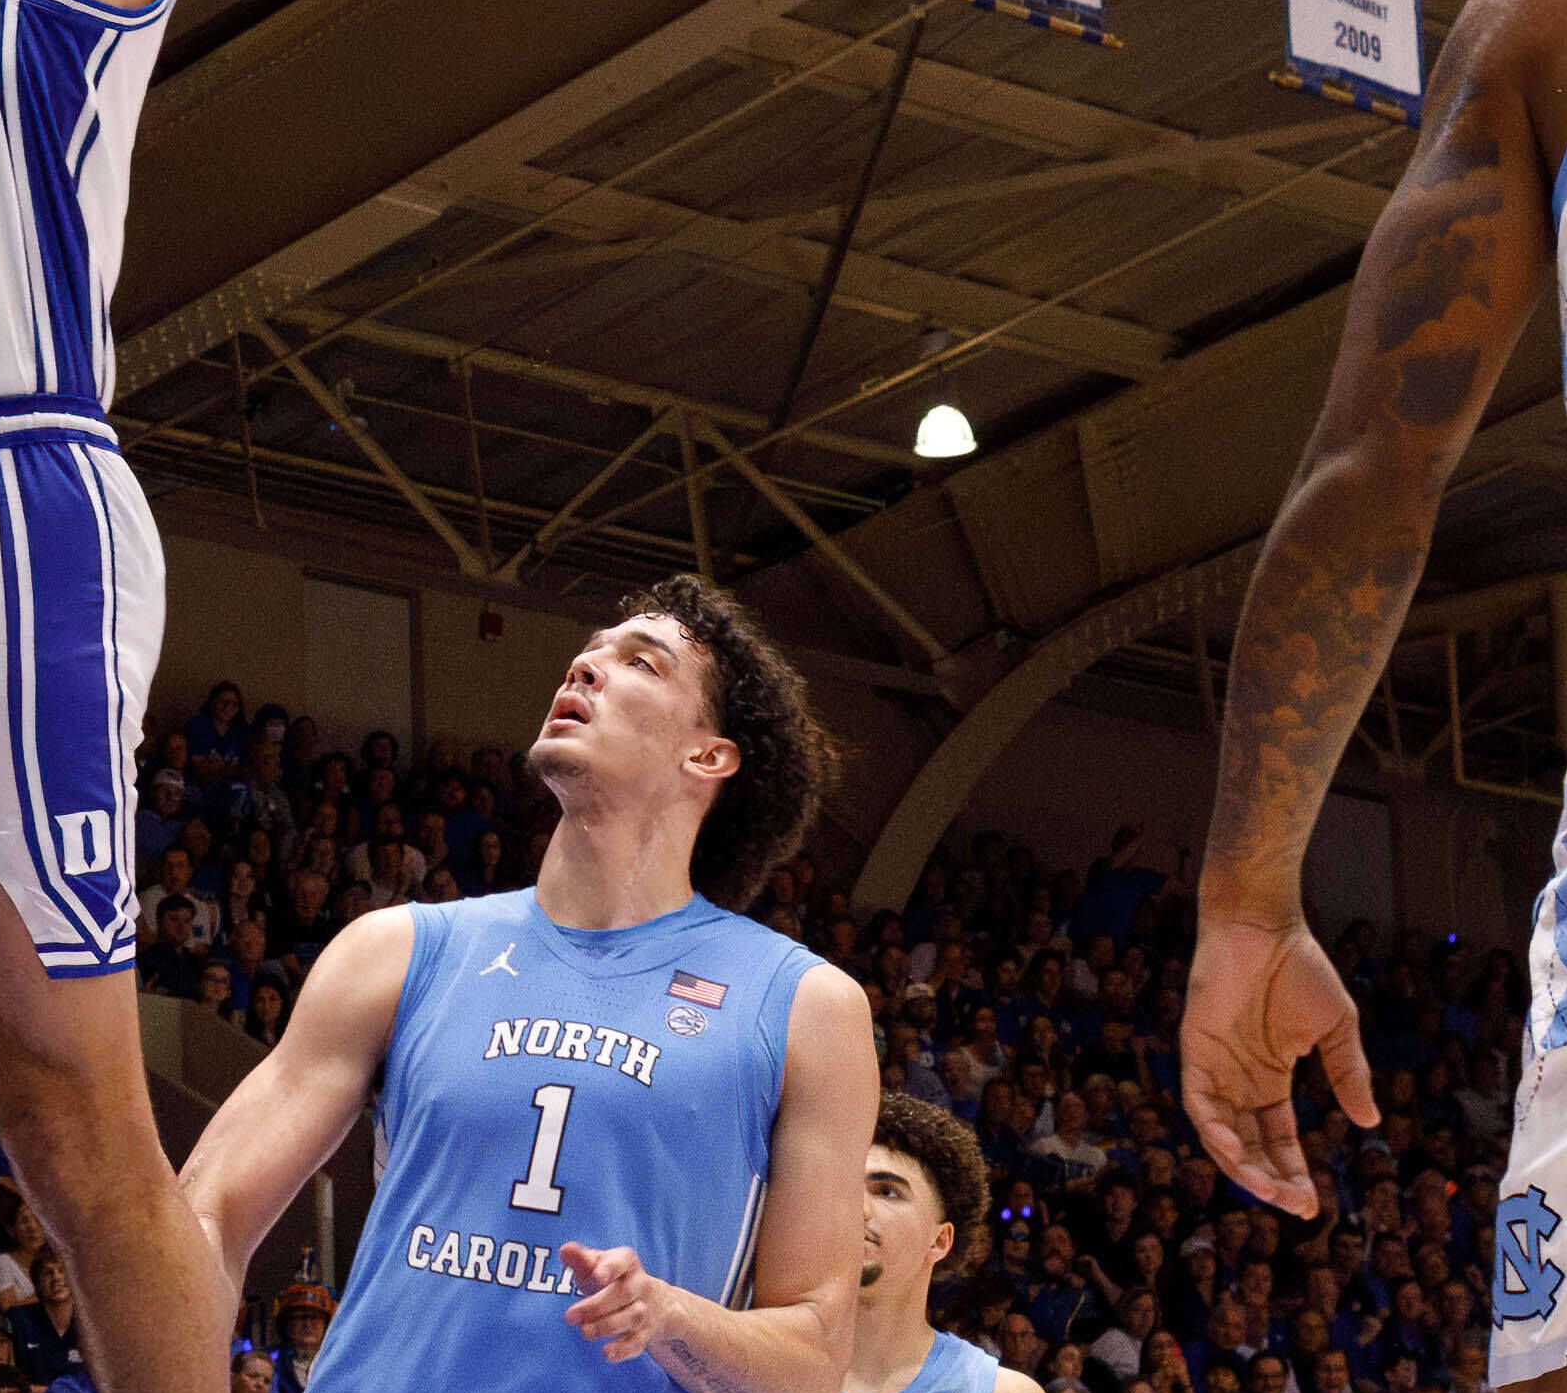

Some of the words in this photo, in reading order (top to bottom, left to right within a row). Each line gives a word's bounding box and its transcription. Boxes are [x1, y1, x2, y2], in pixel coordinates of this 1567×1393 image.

[1335, 21, 1382, 63] 2009
[483, 1017, 662, 1093] NORTH
[509, 1083, 575, 1215] 1
